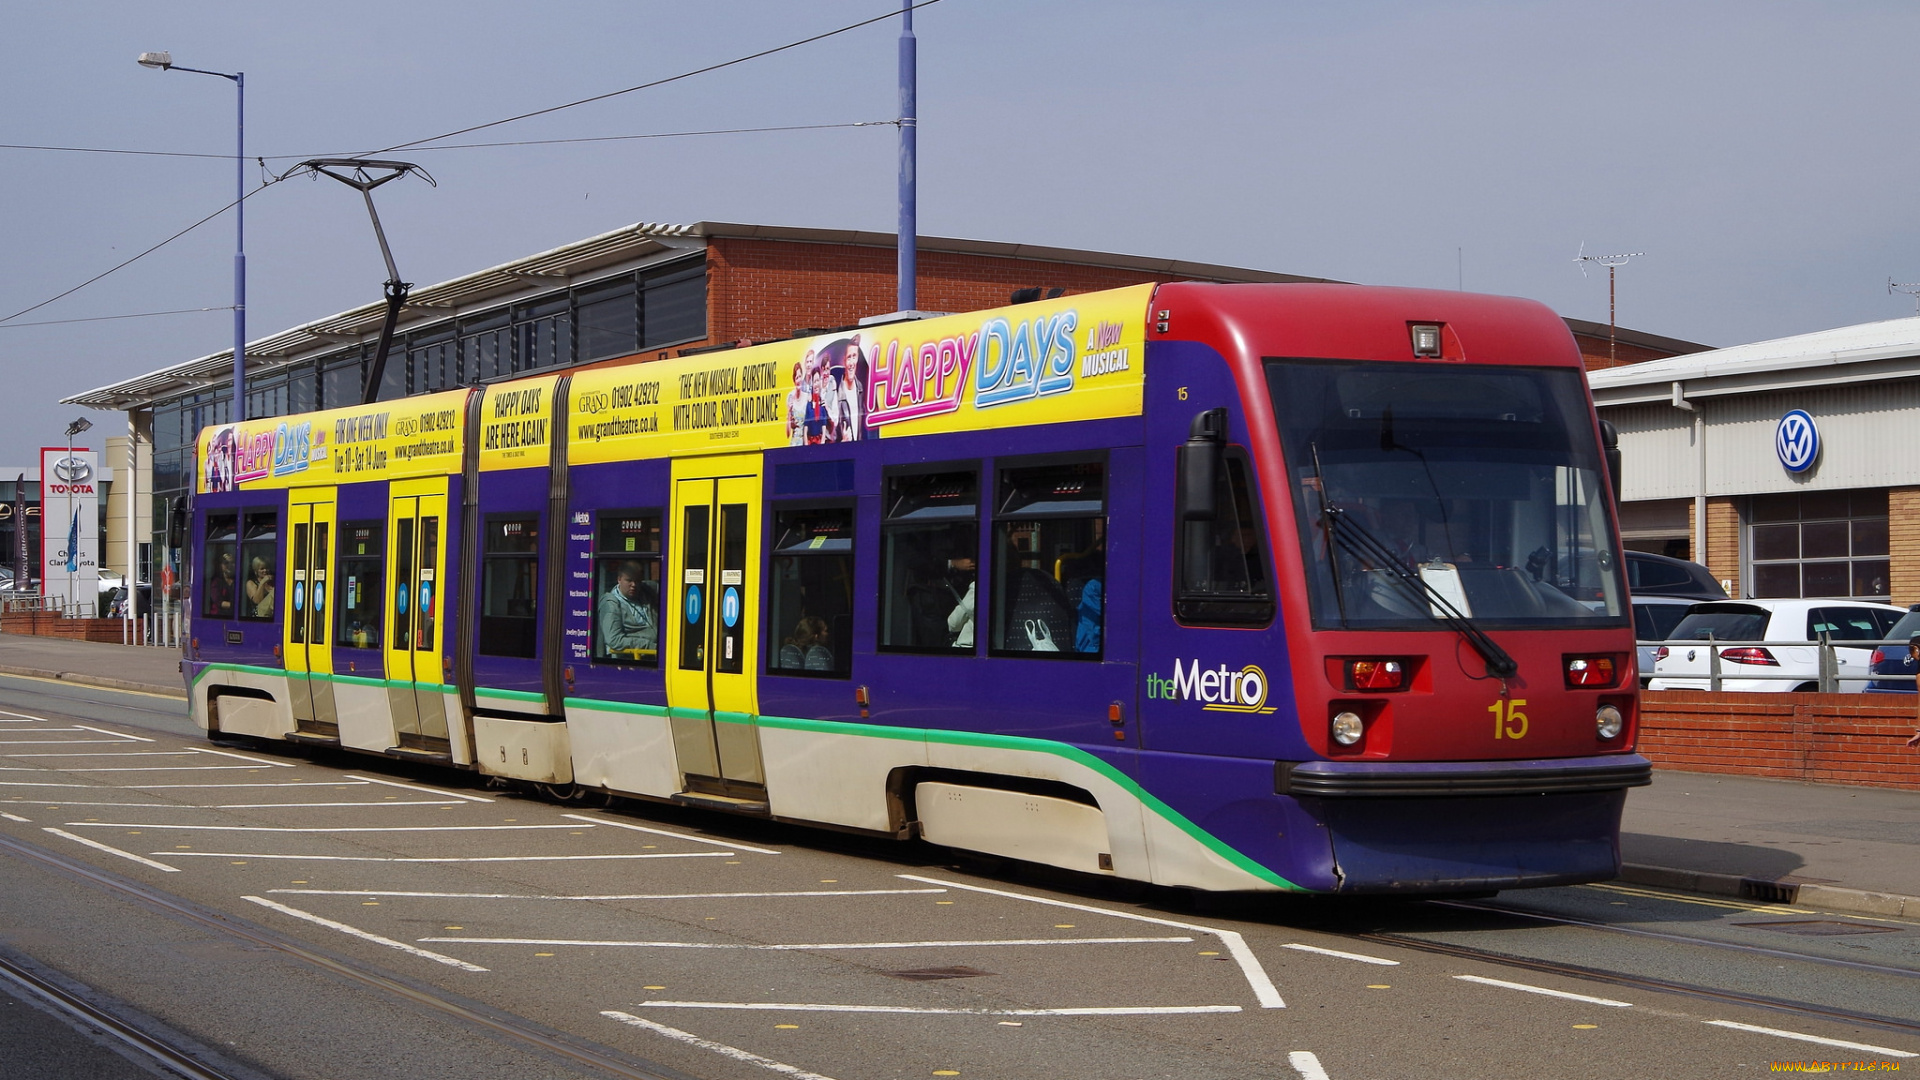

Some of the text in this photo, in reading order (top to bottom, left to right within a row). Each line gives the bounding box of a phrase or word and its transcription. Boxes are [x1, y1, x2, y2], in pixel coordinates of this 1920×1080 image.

[1086, 321, 1123, 351] A New
[866, 310, 1078, 421] HAPPY DAYS
[1082, 347, 1129, 378] MUSICAL
[693, 371, 709, 398] NEW
[742, 361, 777, 392] BURSTING
[1177, 386, 1188, 401] 15
[521, 388, 541, 415] DAYS
[579, 394, 608, 414] GRAND
[612, 382, 660, 409] 01902 429212
[335, 411, 390, 444] FOR ONE WEEK ONLY
[395, 419, 418, 436] GRAND
[420, 409, 455, 433] 01902 429212
[578, 412, 659, 442] www.grandtheatre.co.uk
[673, 404, 690, 431] WITH
[721, 398, 739, 427] SONG
[740, 396, 754, 425] AND
[234, 420, 311, 479] HAPPY DAYS
[395, 435, 454, 461] www.grandtheatre.co.uk
[485, 424, 499, 450] ARE
[501, 422, 520, 448] HERE
[335, 449, 343, 473] Tue
[355, 446, 364, 471] Sat
[373, 444, 387, 469] June
[1488, 699, 1528, 739] 15
